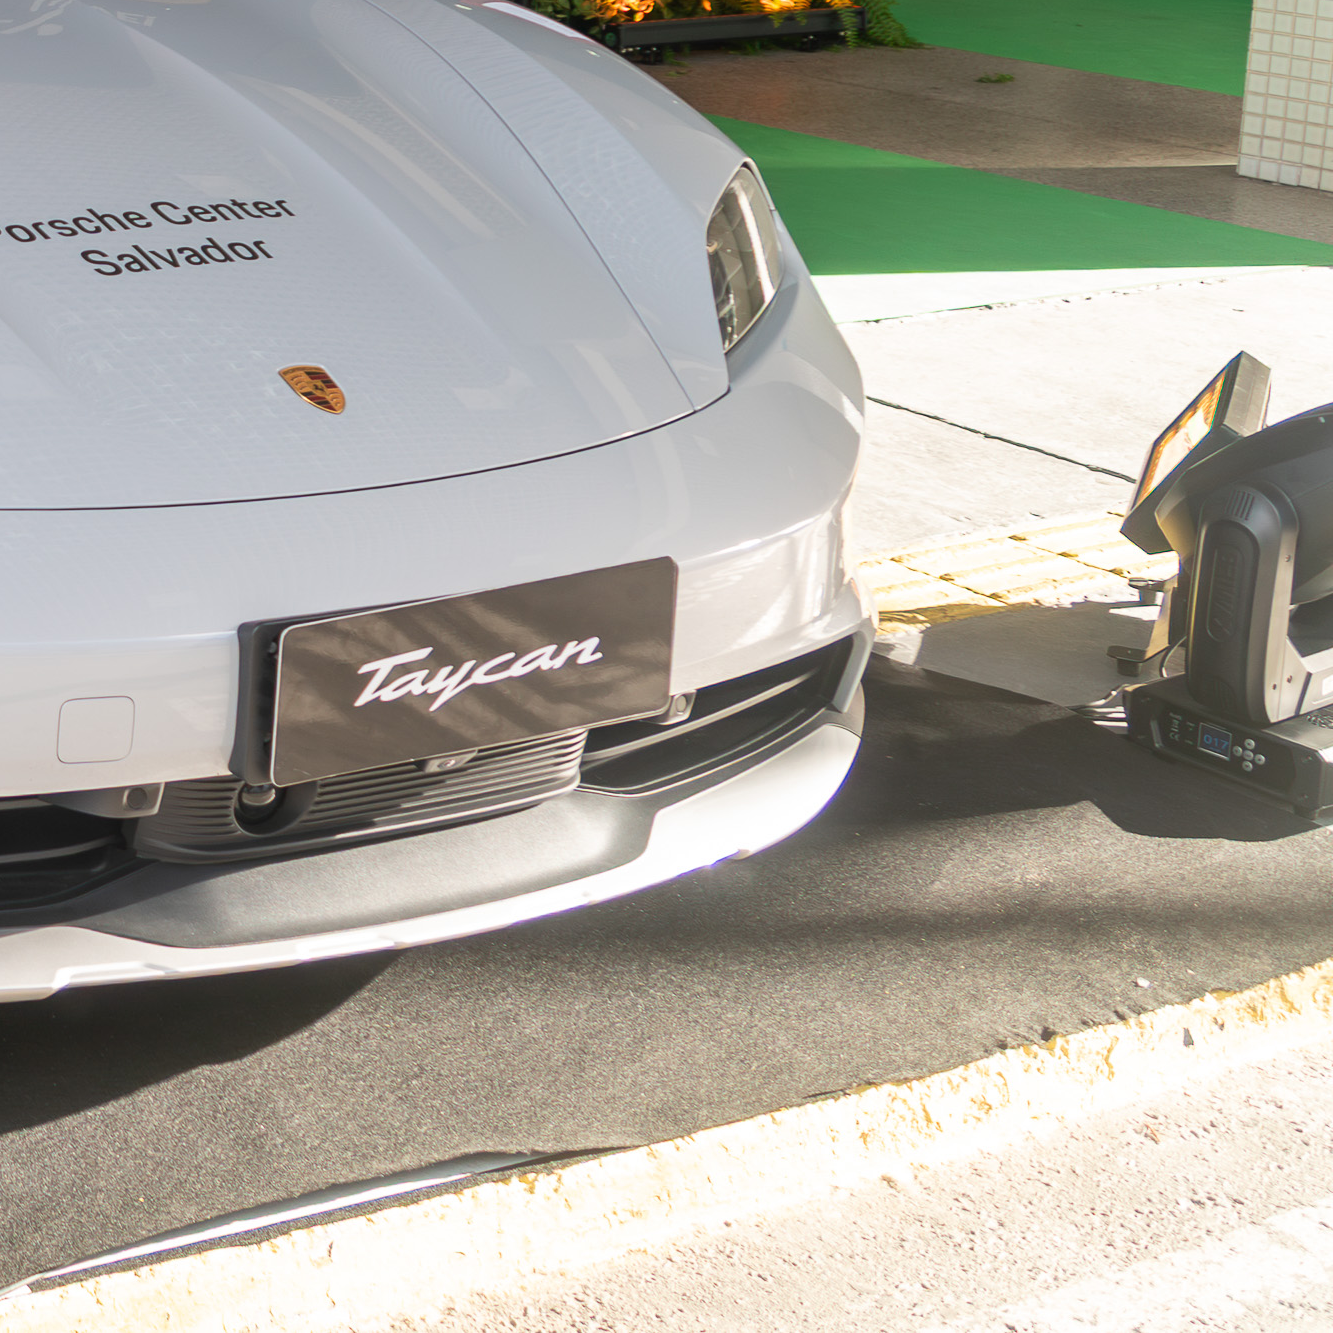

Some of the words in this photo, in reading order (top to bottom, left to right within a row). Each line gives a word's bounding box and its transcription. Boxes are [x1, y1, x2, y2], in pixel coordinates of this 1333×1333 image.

[151, 193, 296, 226] Center
[80, 236, 274, 278] Salvador
[354, 635, 603, 712] Taycan
